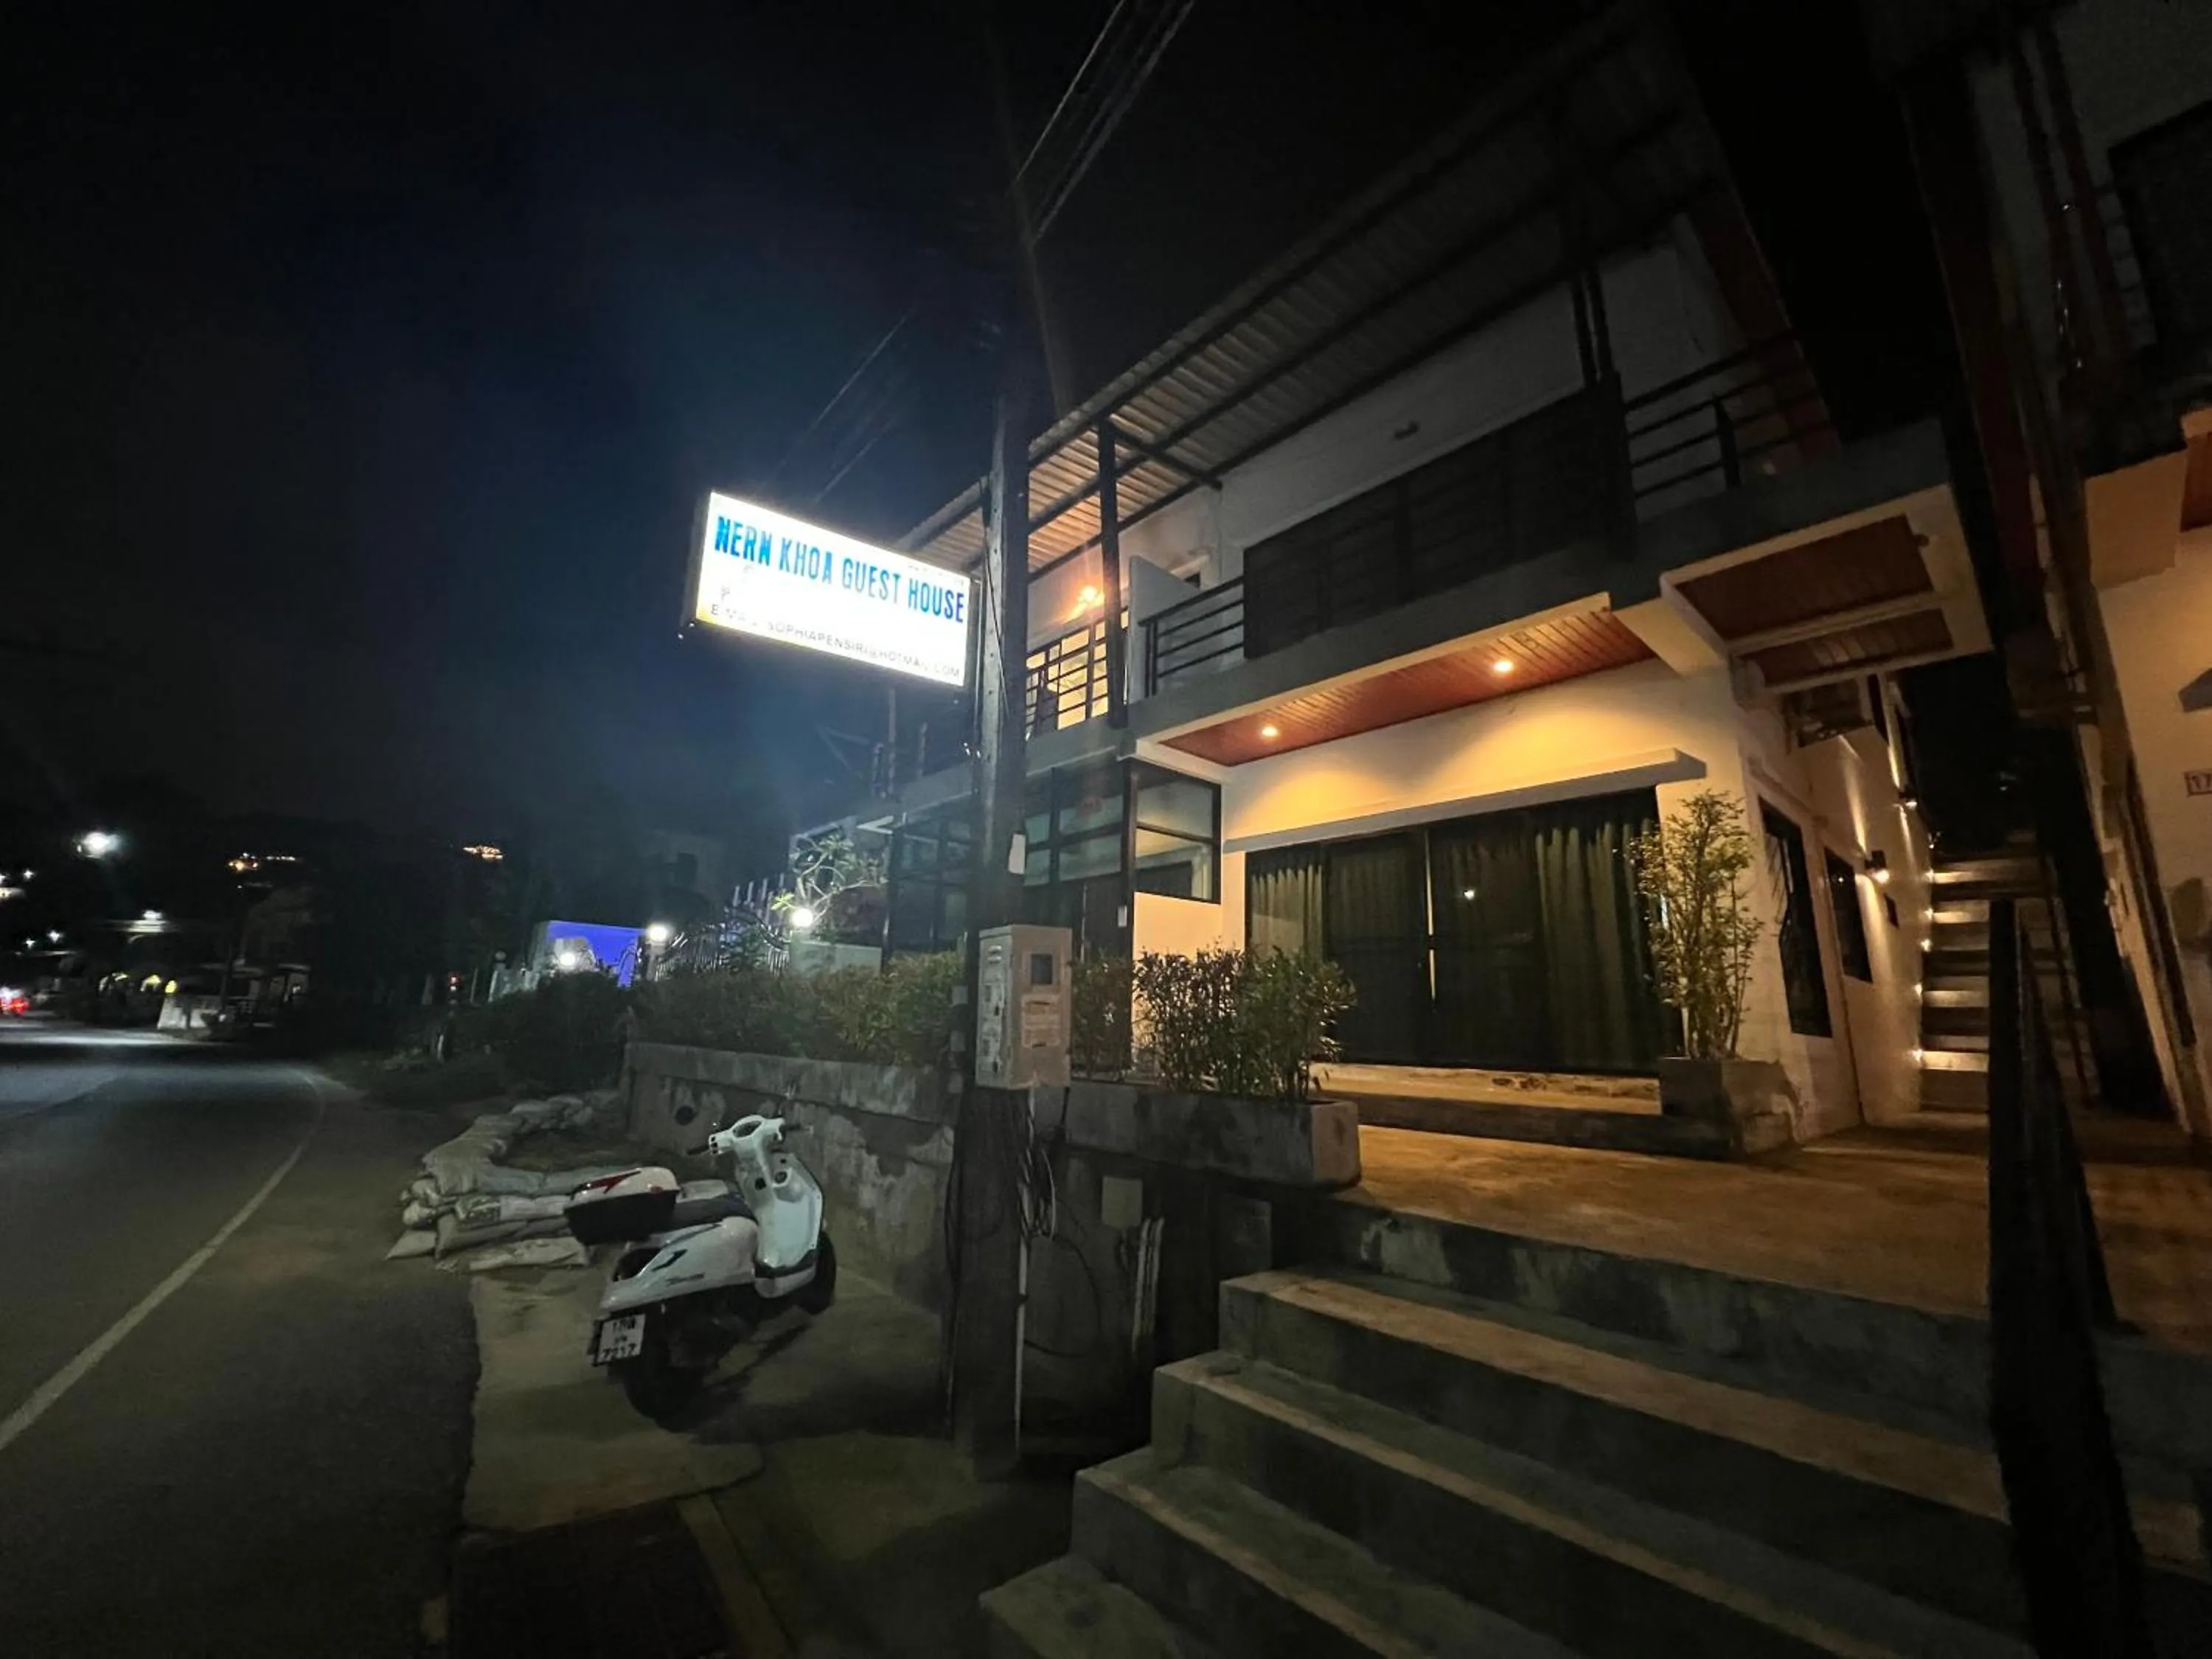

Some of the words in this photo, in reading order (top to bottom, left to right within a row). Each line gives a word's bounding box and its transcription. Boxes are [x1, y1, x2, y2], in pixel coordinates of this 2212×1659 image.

[714, 515, 772, 567] NERN
[779, 538, 832, 584] KHOA
[842, 557, 901, 604] GUEST
[908, 577, 964, 623] HOUSE
